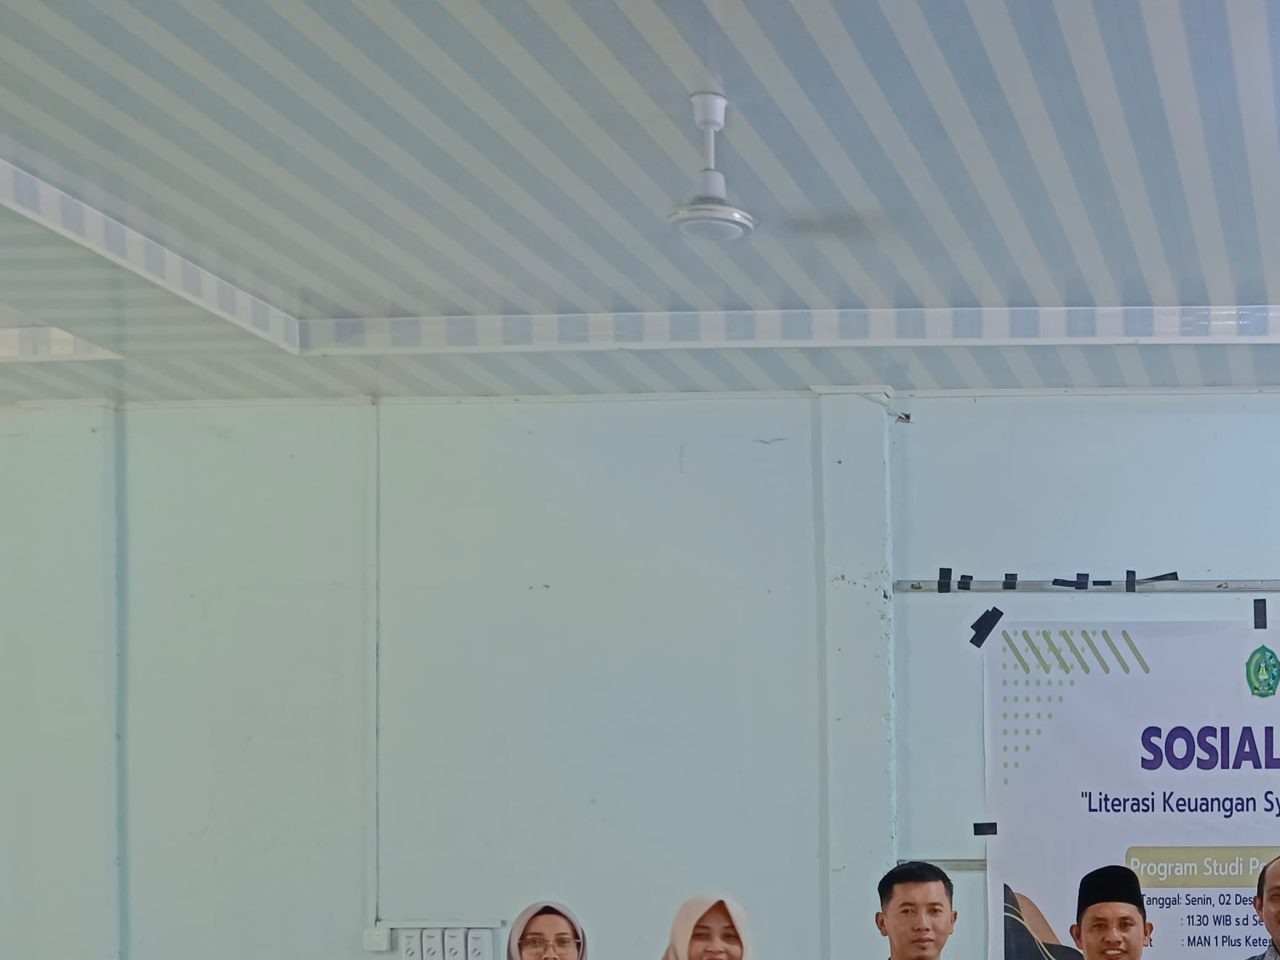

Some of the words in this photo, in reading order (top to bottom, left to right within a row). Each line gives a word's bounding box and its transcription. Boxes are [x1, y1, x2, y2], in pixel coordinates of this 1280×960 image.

[1081, 791, 1155, 813] "Literasi
[1162, 791, 1257, 819] Keuangan
[1130, 857, 1198, 881] Program
[1203, 856, 1243, 876] Studi
[1184, 893, 1215, 908] Senin,
[1218, 893, 1232, 906] 02
[1234, 894, 1253, 906] Des
[1212, 914, 1232, 927] WIB
[1187, 935, 1211, 948] MAN
[1215, 935, 1219, 948] 1
[1221, 934, 1242, 948] Plus
